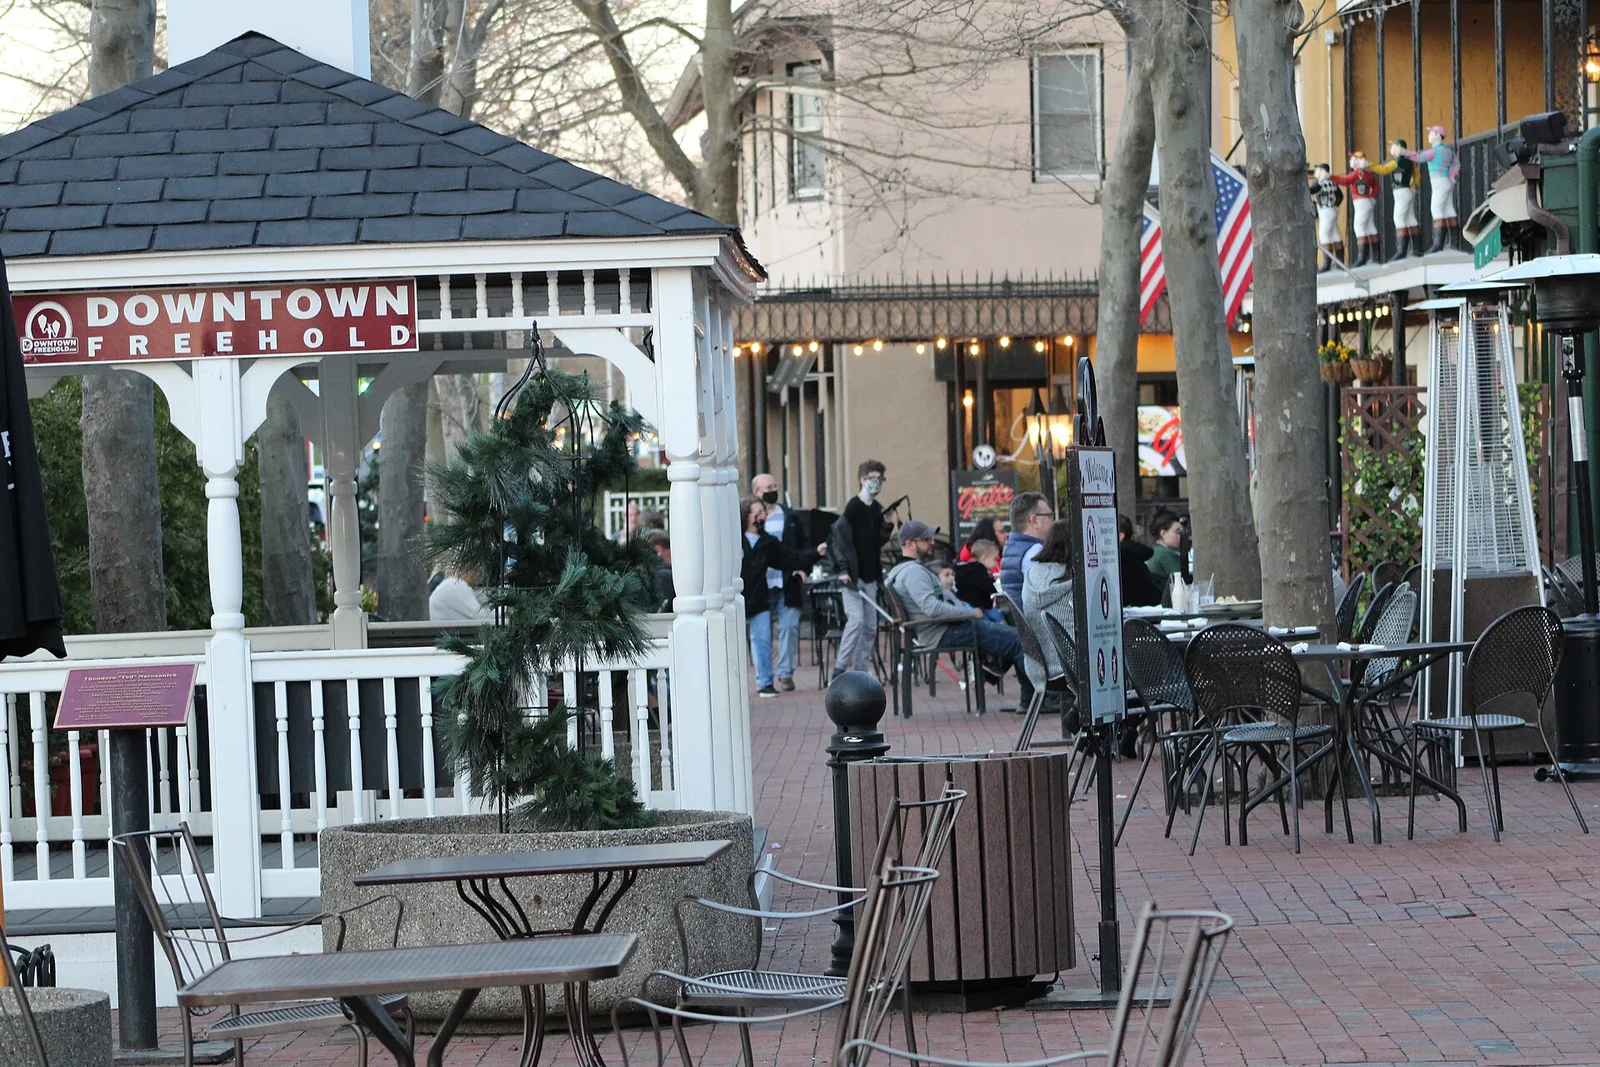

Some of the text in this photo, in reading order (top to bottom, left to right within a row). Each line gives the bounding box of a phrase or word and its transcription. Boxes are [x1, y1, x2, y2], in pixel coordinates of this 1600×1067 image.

[86, 286, 409, 328] DOWNTOWN
[22, 338, 76, 352] DOWNTOWN
[88, 325, 411, 357] FREEHOLD
[1085, 456, 1109, 486] Welcome
